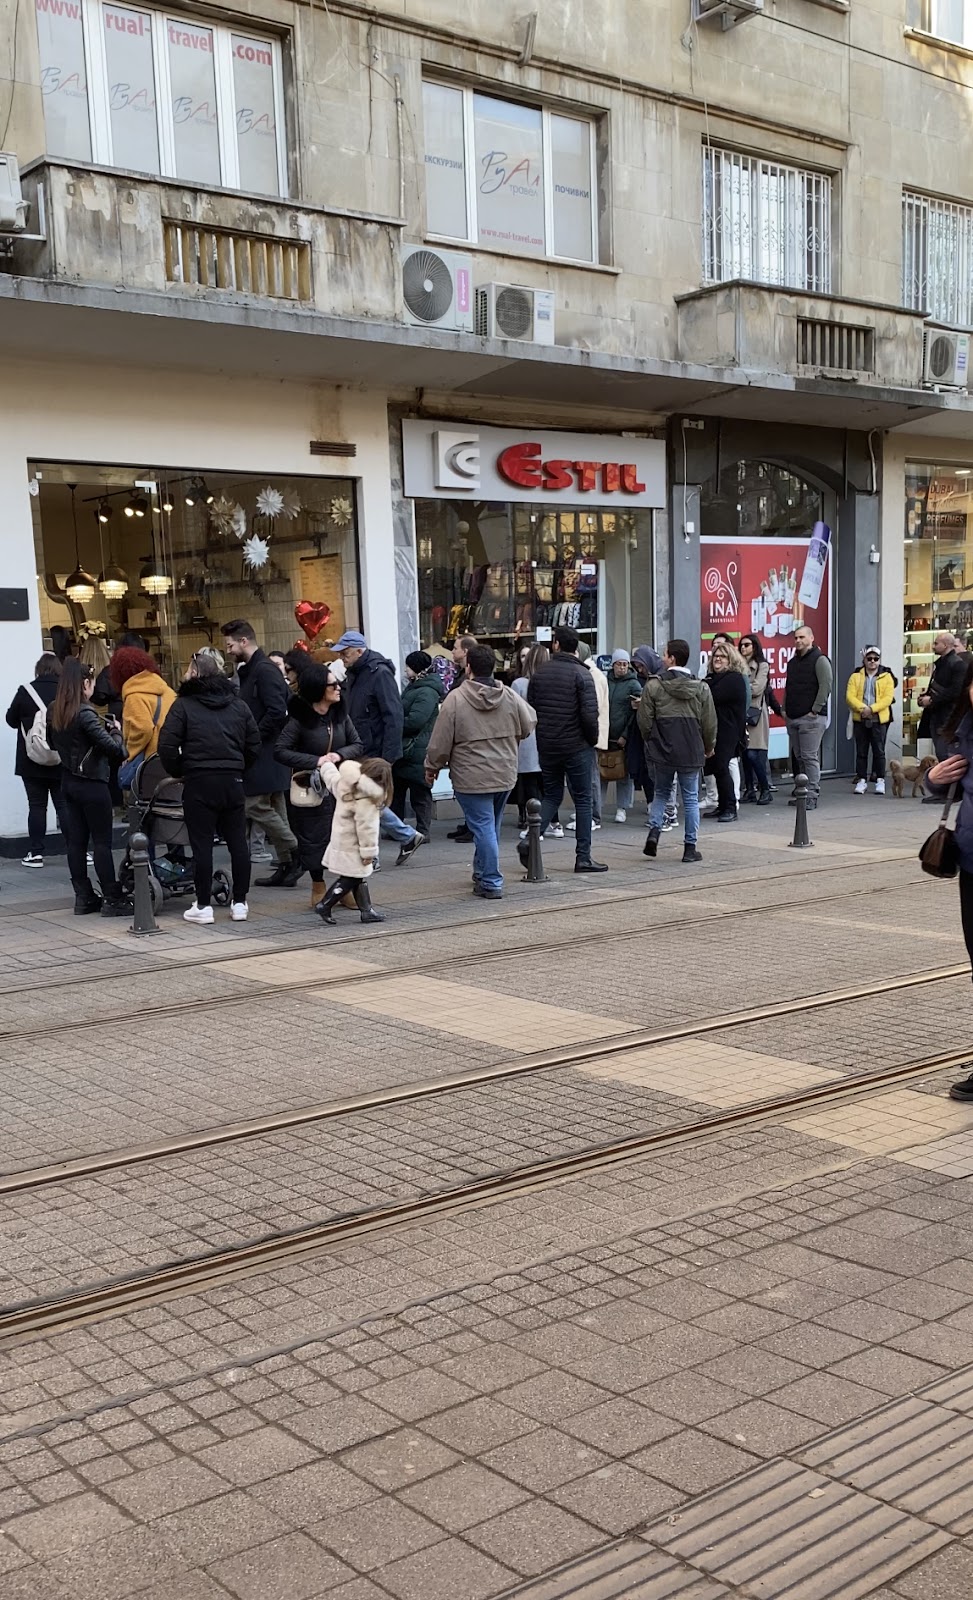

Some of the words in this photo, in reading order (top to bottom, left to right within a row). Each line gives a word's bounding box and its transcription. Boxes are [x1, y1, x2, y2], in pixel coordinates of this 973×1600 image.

[168, 26, 212, 53] travel
[554, 184, 590, 199] ПОЧИВКИ
[709, 601, 735, 617] INA
